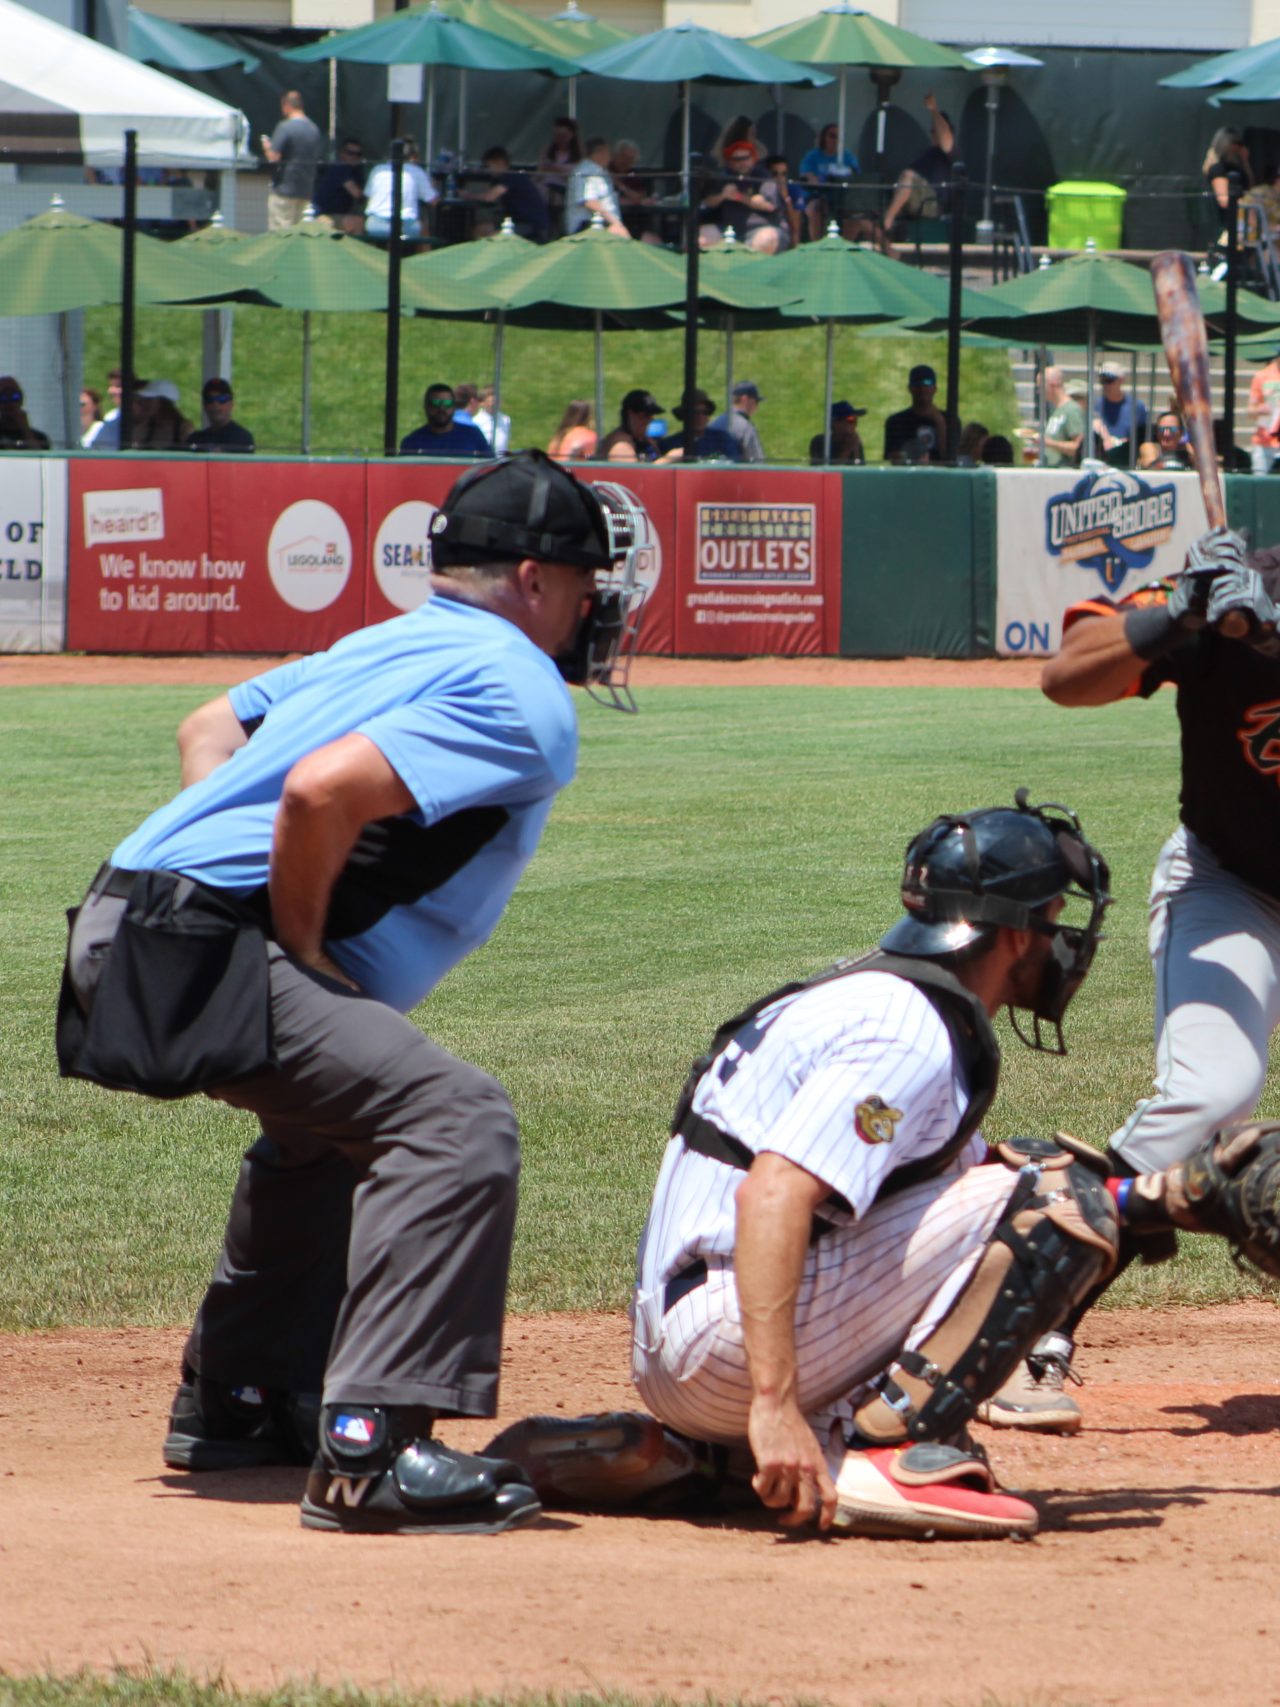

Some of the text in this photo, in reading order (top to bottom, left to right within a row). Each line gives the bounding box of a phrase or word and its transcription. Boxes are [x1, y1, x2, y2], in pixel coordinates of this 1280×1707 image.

[6, 521, 43, 543] OF
[91, 510, 161, 535] heard?
[1051, 491, 1122, 546] UNITED
[1112, 491, 1173, 539] SHORE
[100, 551, 246, 580] We know how
[288, 554, 344, 567] LEGOLAND
[383, 543, 413, 567] SEA
[701, 540, 811, 571] OUTLETS
[100, 584, 240, 613] to kid around.
[1004, 621, 1050, 651] ON
